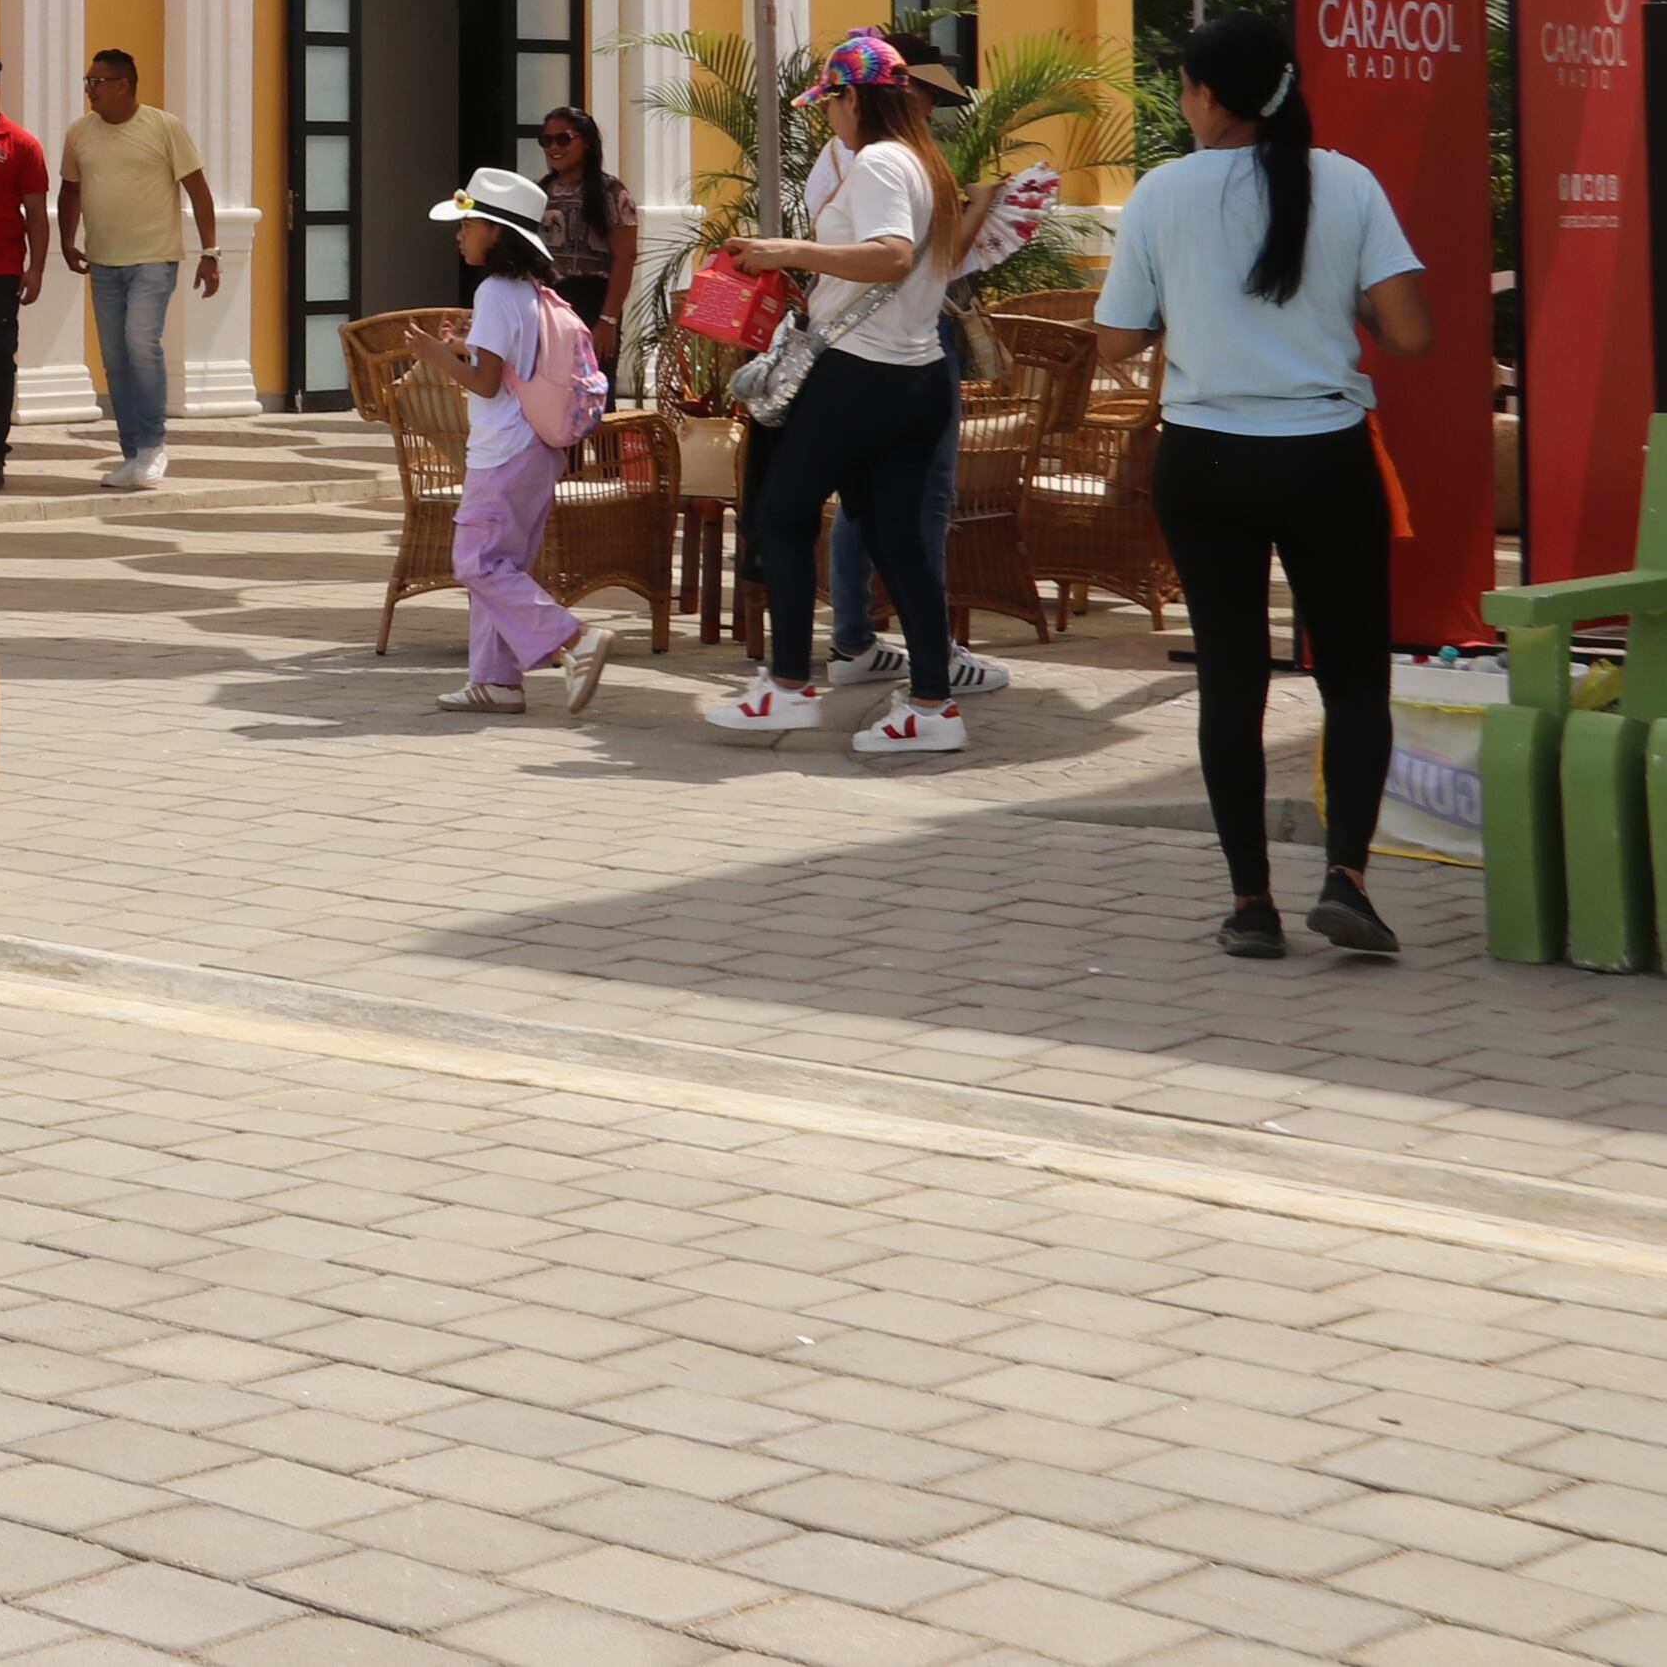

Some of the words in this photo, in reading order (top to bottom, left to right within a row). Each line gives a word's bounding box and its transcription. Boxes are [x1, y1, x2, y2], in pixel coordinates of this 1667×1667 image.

[1540, 22, 1628, 67] CARACOL
[1347, 53, 1433, 82] RADIO
[1558, 68, 1611, 90] RADIO
